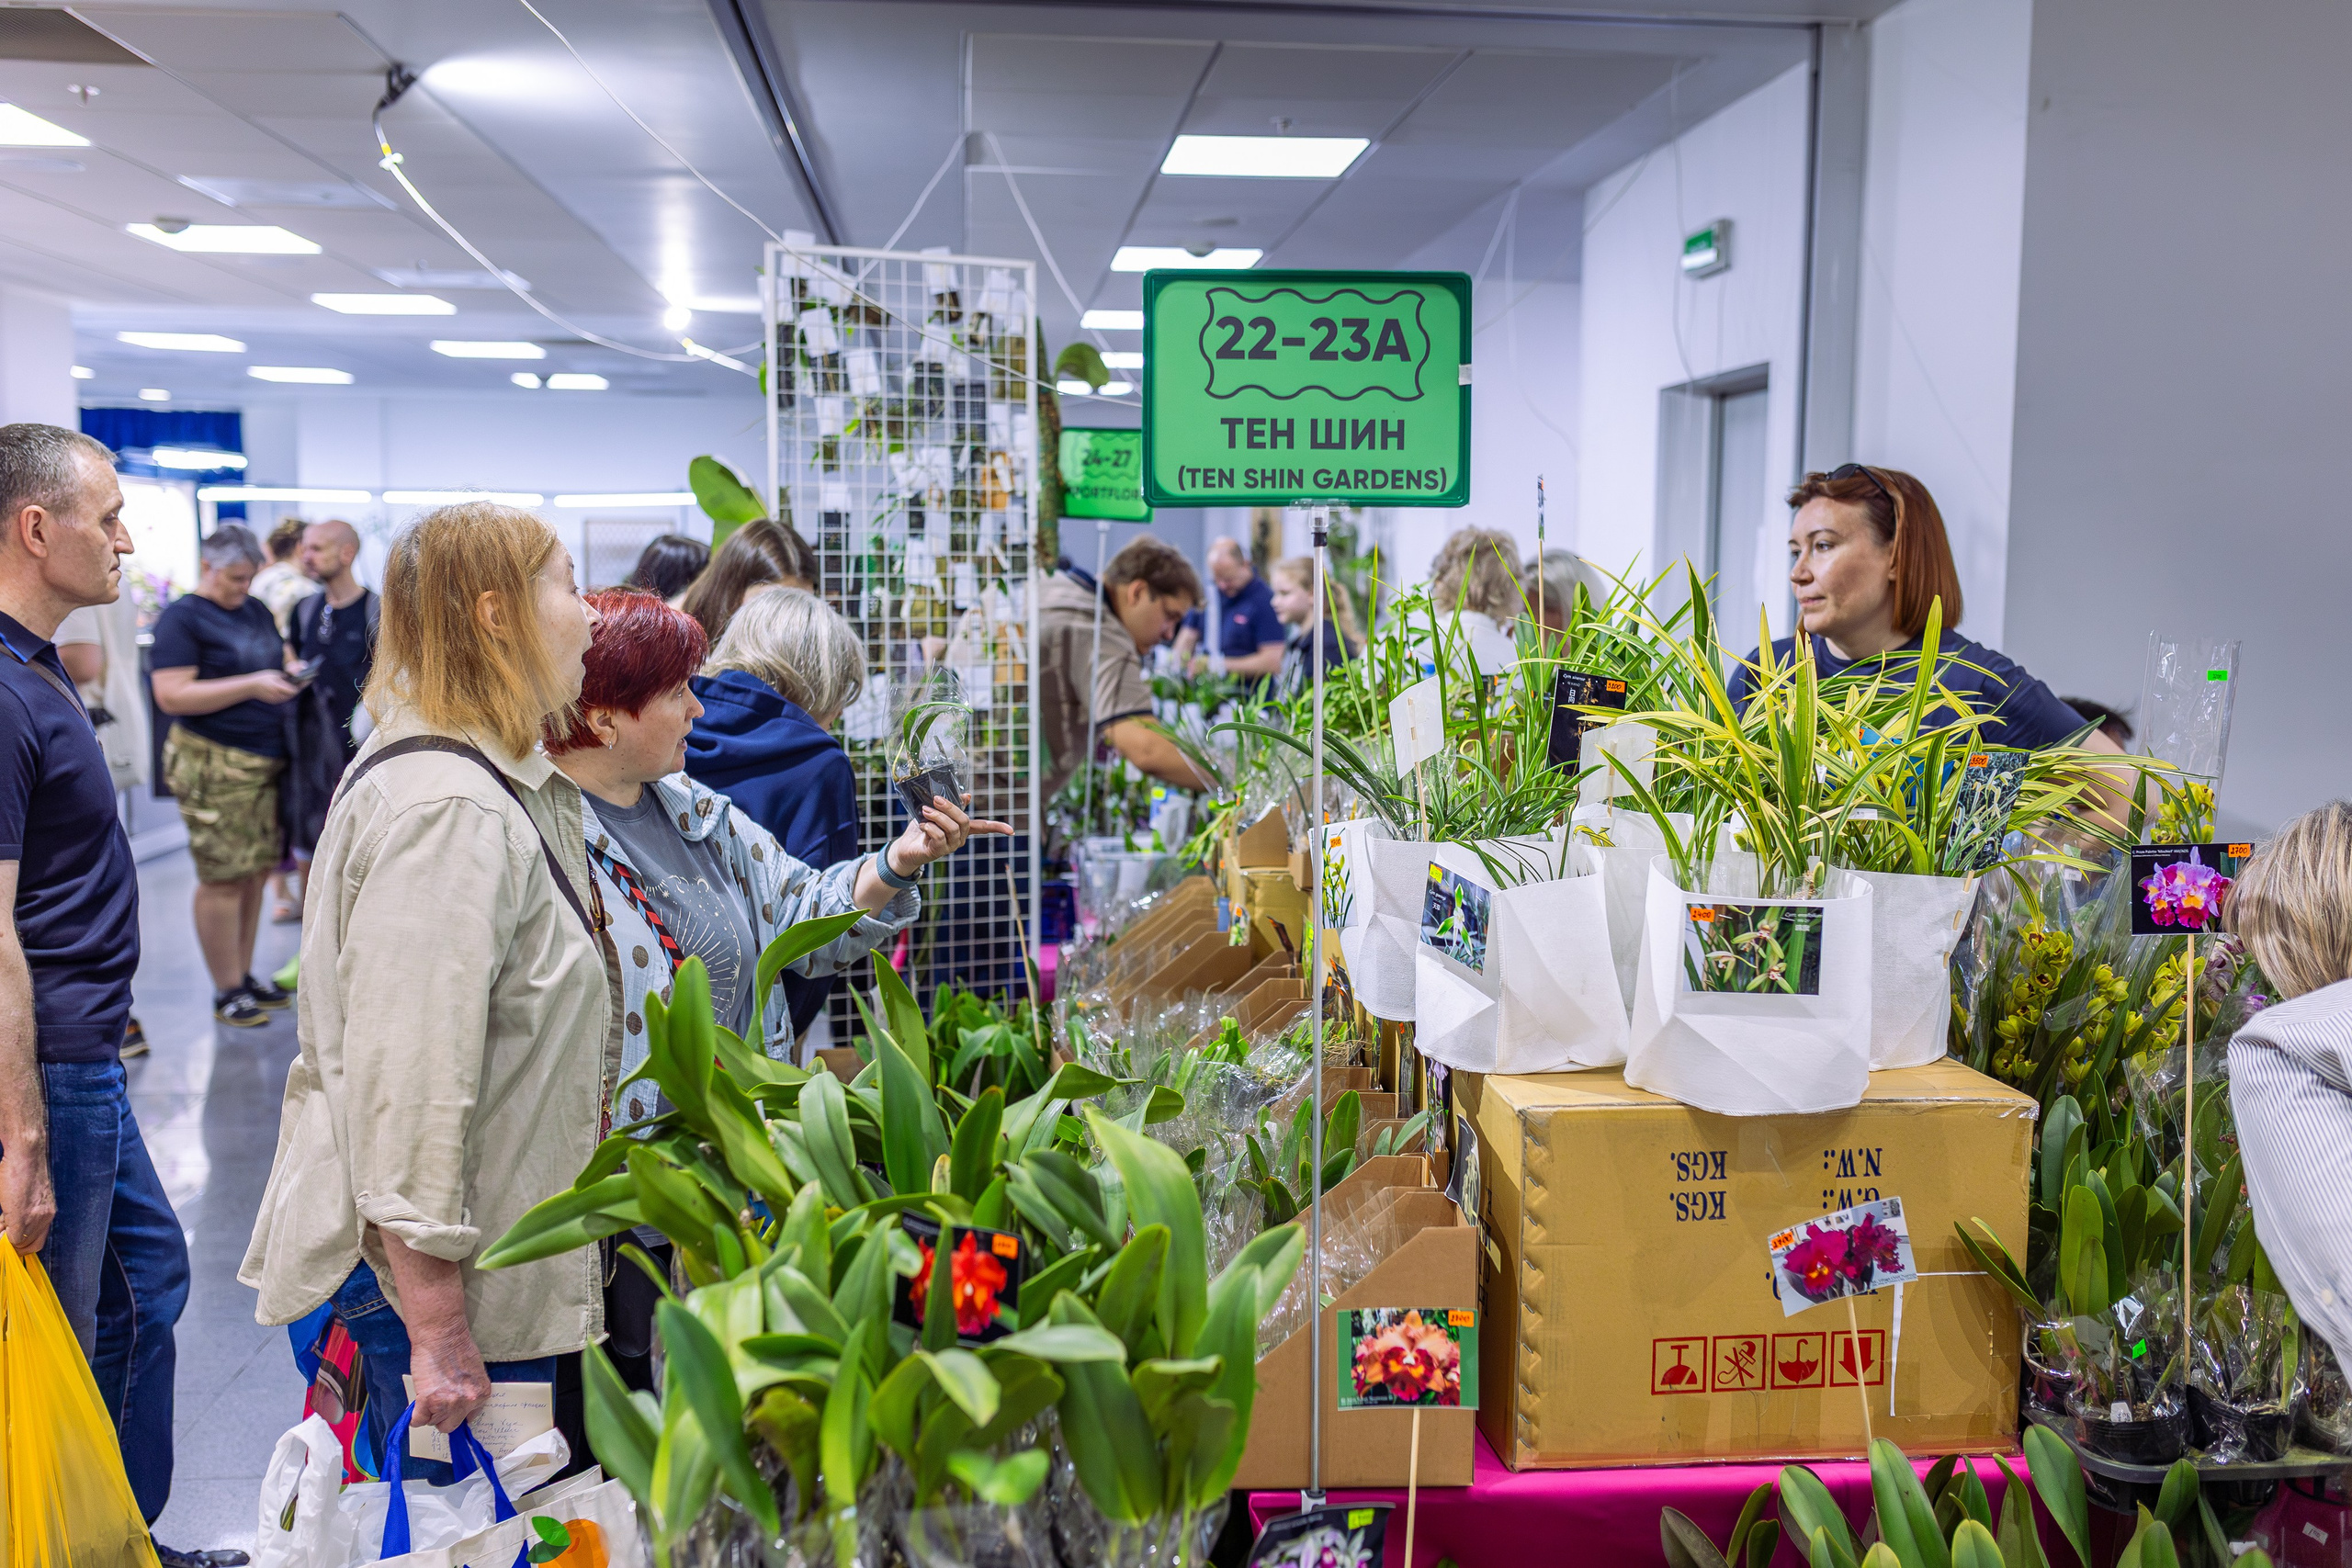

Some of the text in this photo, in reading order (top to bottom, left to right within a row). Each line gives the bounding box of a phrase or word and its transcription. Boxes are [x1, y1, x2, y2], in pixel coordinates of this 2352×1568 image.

[1216, 316, 1411, 362] 22-23A
[1220, 418, 1405, 450] ТЕН ШИН
[1081, 449, 1132, 468] 24-27
[1178, 466, 1447, 492] (TEN SHIN GARDENS)
[1670, 1147, 1883, 1182] N.W.: KGS.
[1669, 1190, 1727, 1223] KGS.
